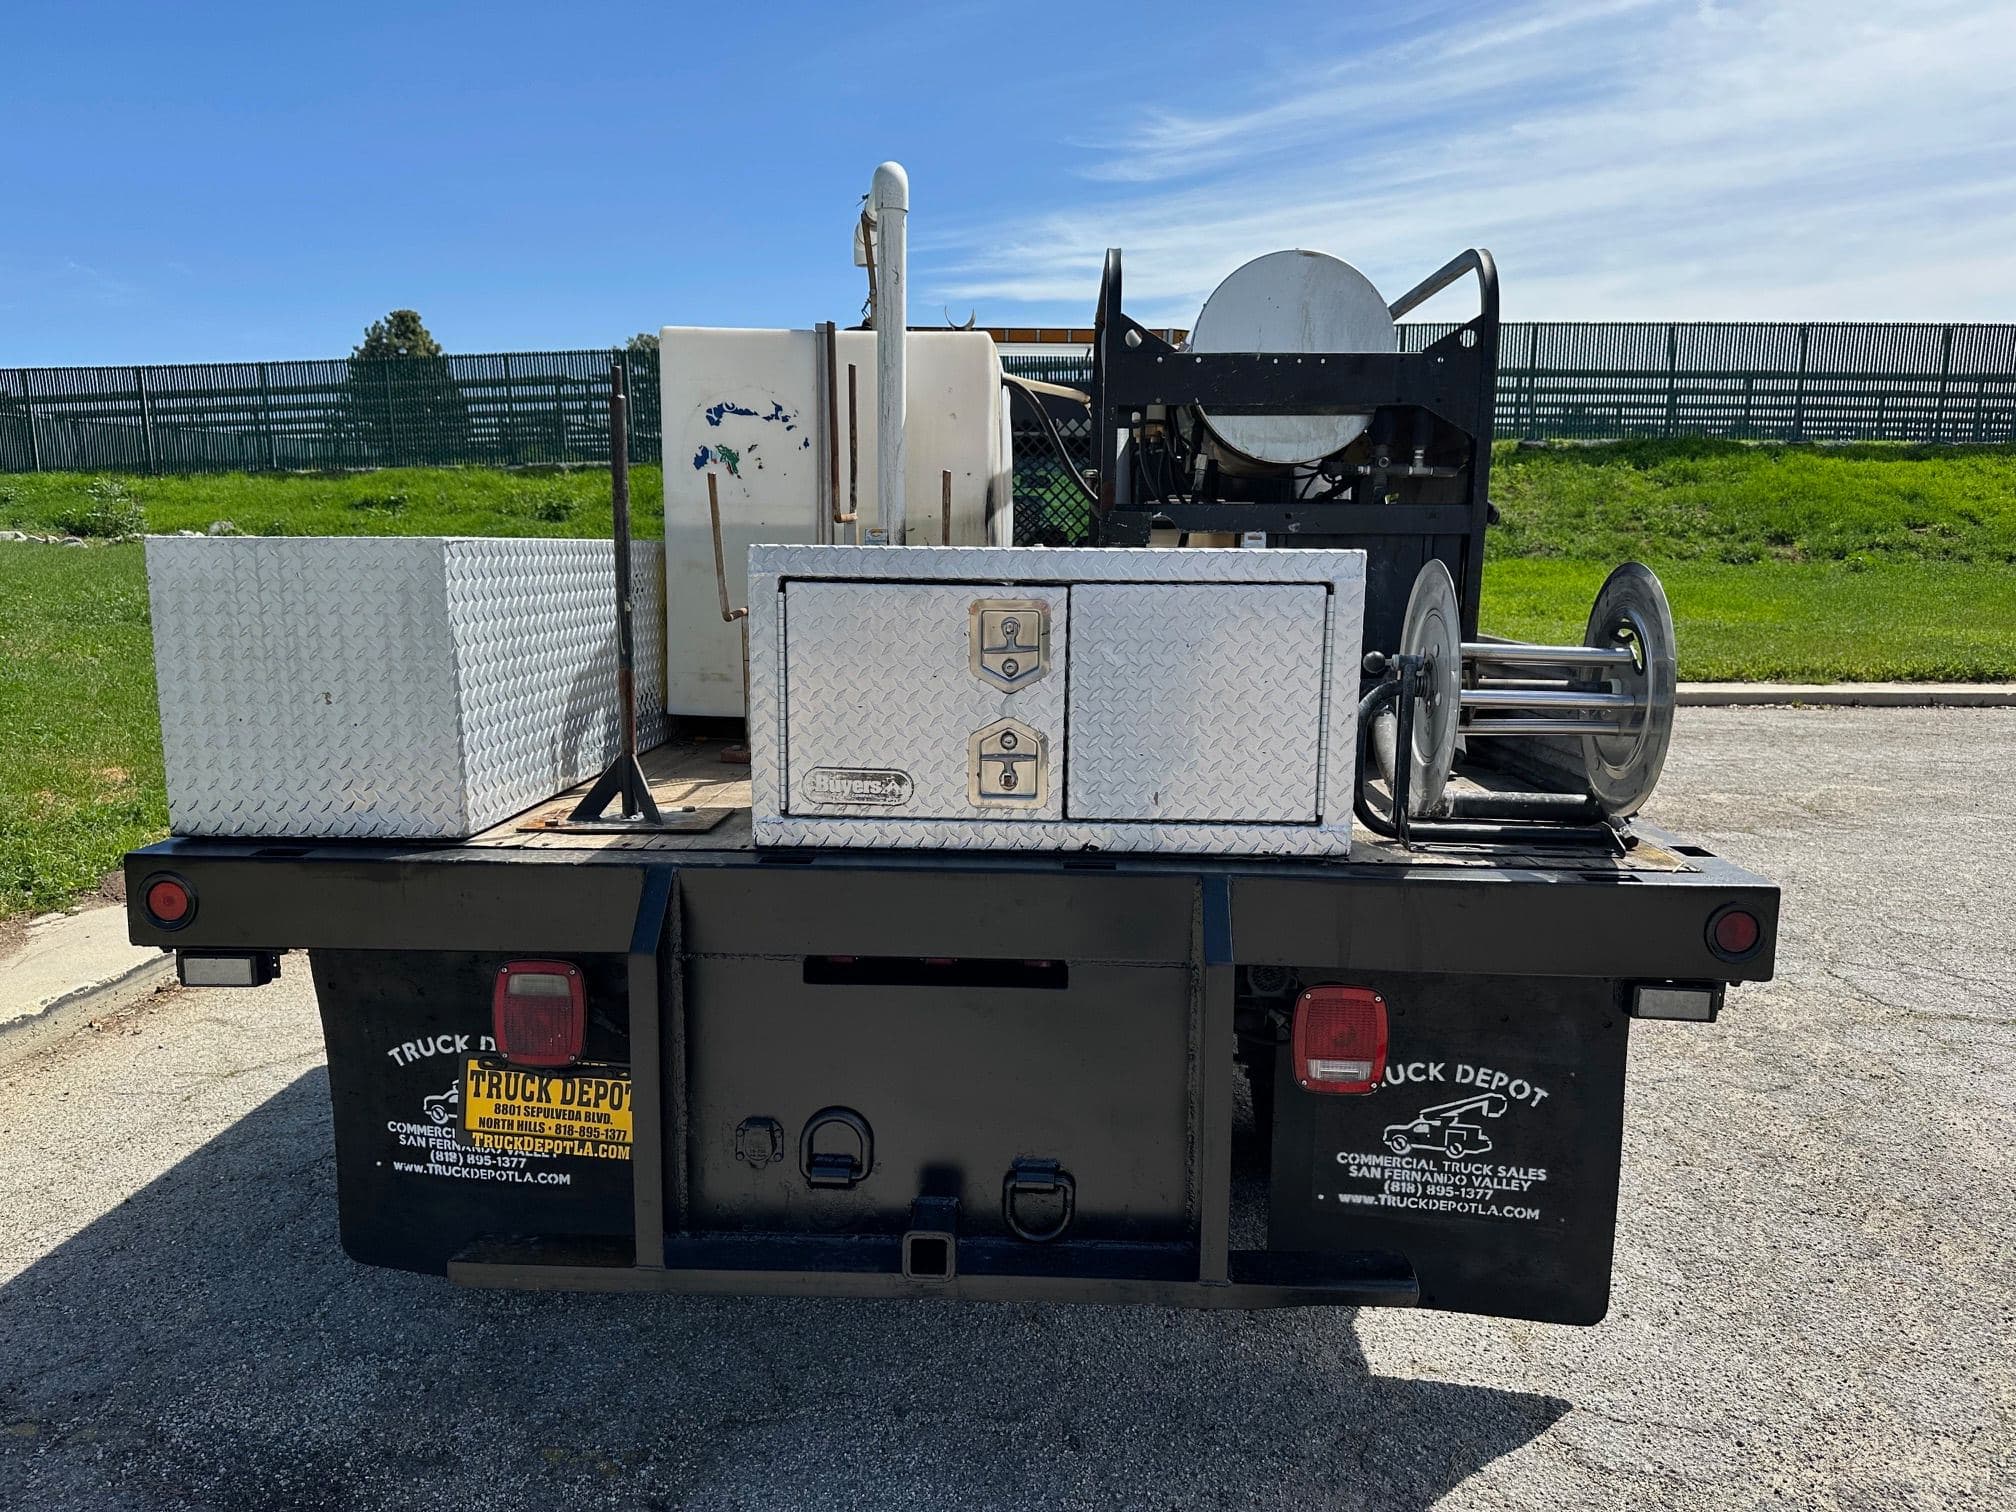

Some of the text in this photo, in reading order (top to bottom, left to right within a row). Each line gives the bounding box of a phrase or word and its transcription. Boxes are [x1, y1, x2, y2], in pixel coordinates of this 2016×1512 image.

[814, 774, 883, 797] Buyers
[387, 1034, 470, 1067] TRUCK
[470, 1070, 552, 1104] TRUCK
[1382, 1062, 1550, 1108] UCK DEPOT
[494, 1103, 613, 1125] 8801 SEPULVEDA BLVD.
[387, 1120, 456, 1139] COMMERCI
[399, 1134, 426, 1148] SAN
[478, 1116, 628, 1141] NORTH HILLS 818-895-1377
[472, 1132, 630, 1160] TRUCKDEPOTLA.COM
[393, 1160, 571, 1185] www.TRUCKDEPOTLA.COM
[466, 1154, 527, 1169] 895-1377
[1336, 1152, 1547, 1182] COMMERCIAL TRUCK SALES
[1349, 1165, 1532, 1192] SAN FERNANDO VALLEY
[1384, 1180, 1494, 1201] (818) 895-1377
[1338, 1193, 1540, 1220] www.TRUCKDEPOTLA.COM
